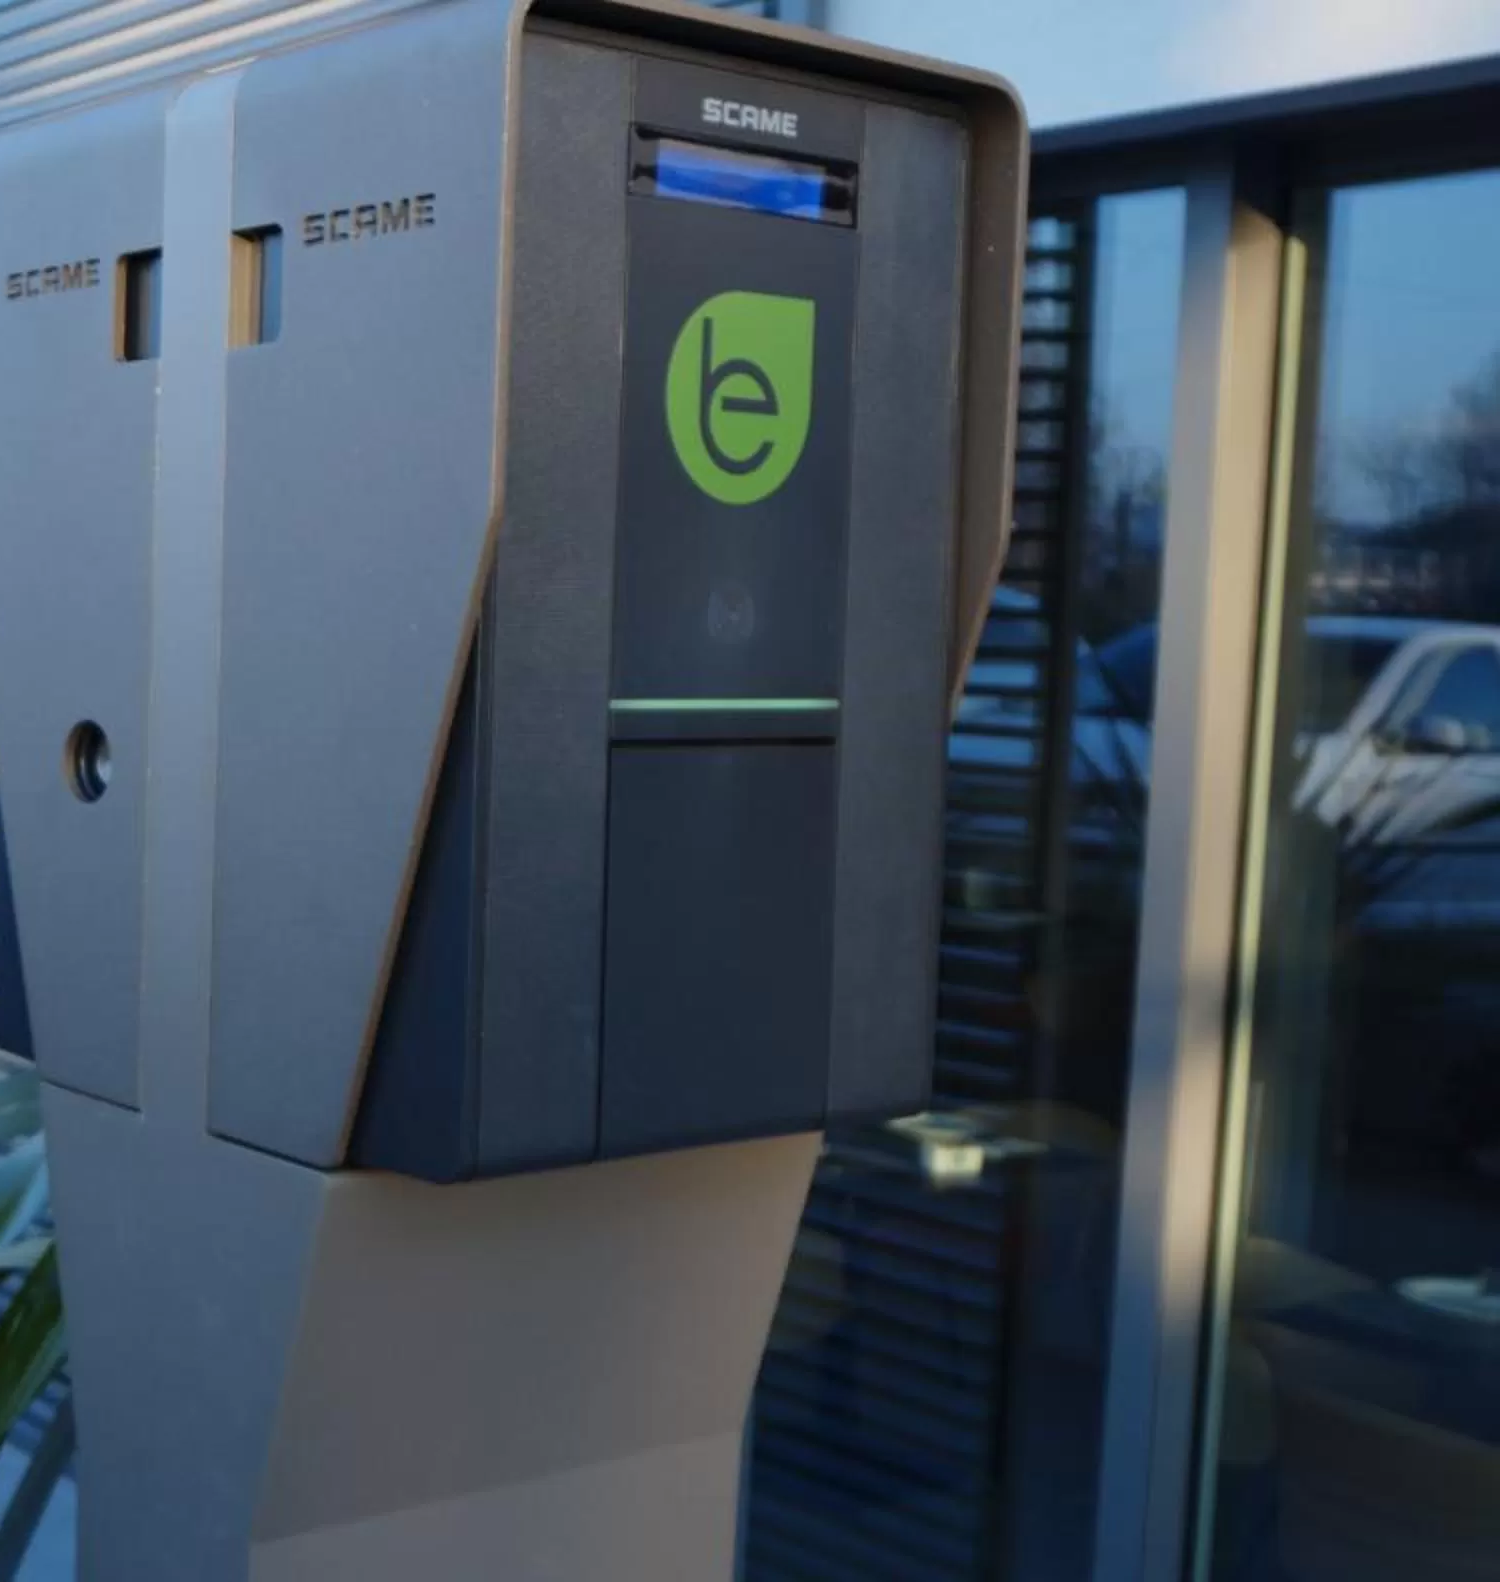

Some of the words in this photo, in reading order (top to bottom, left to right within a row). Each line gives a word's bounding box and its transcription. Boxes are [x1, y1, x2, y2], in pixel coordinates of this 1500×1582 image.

[702, 97, 798, 137] SCAME
[304, 193, 436, 246] SCAME
[6, 258, 100, 299] SCAME
